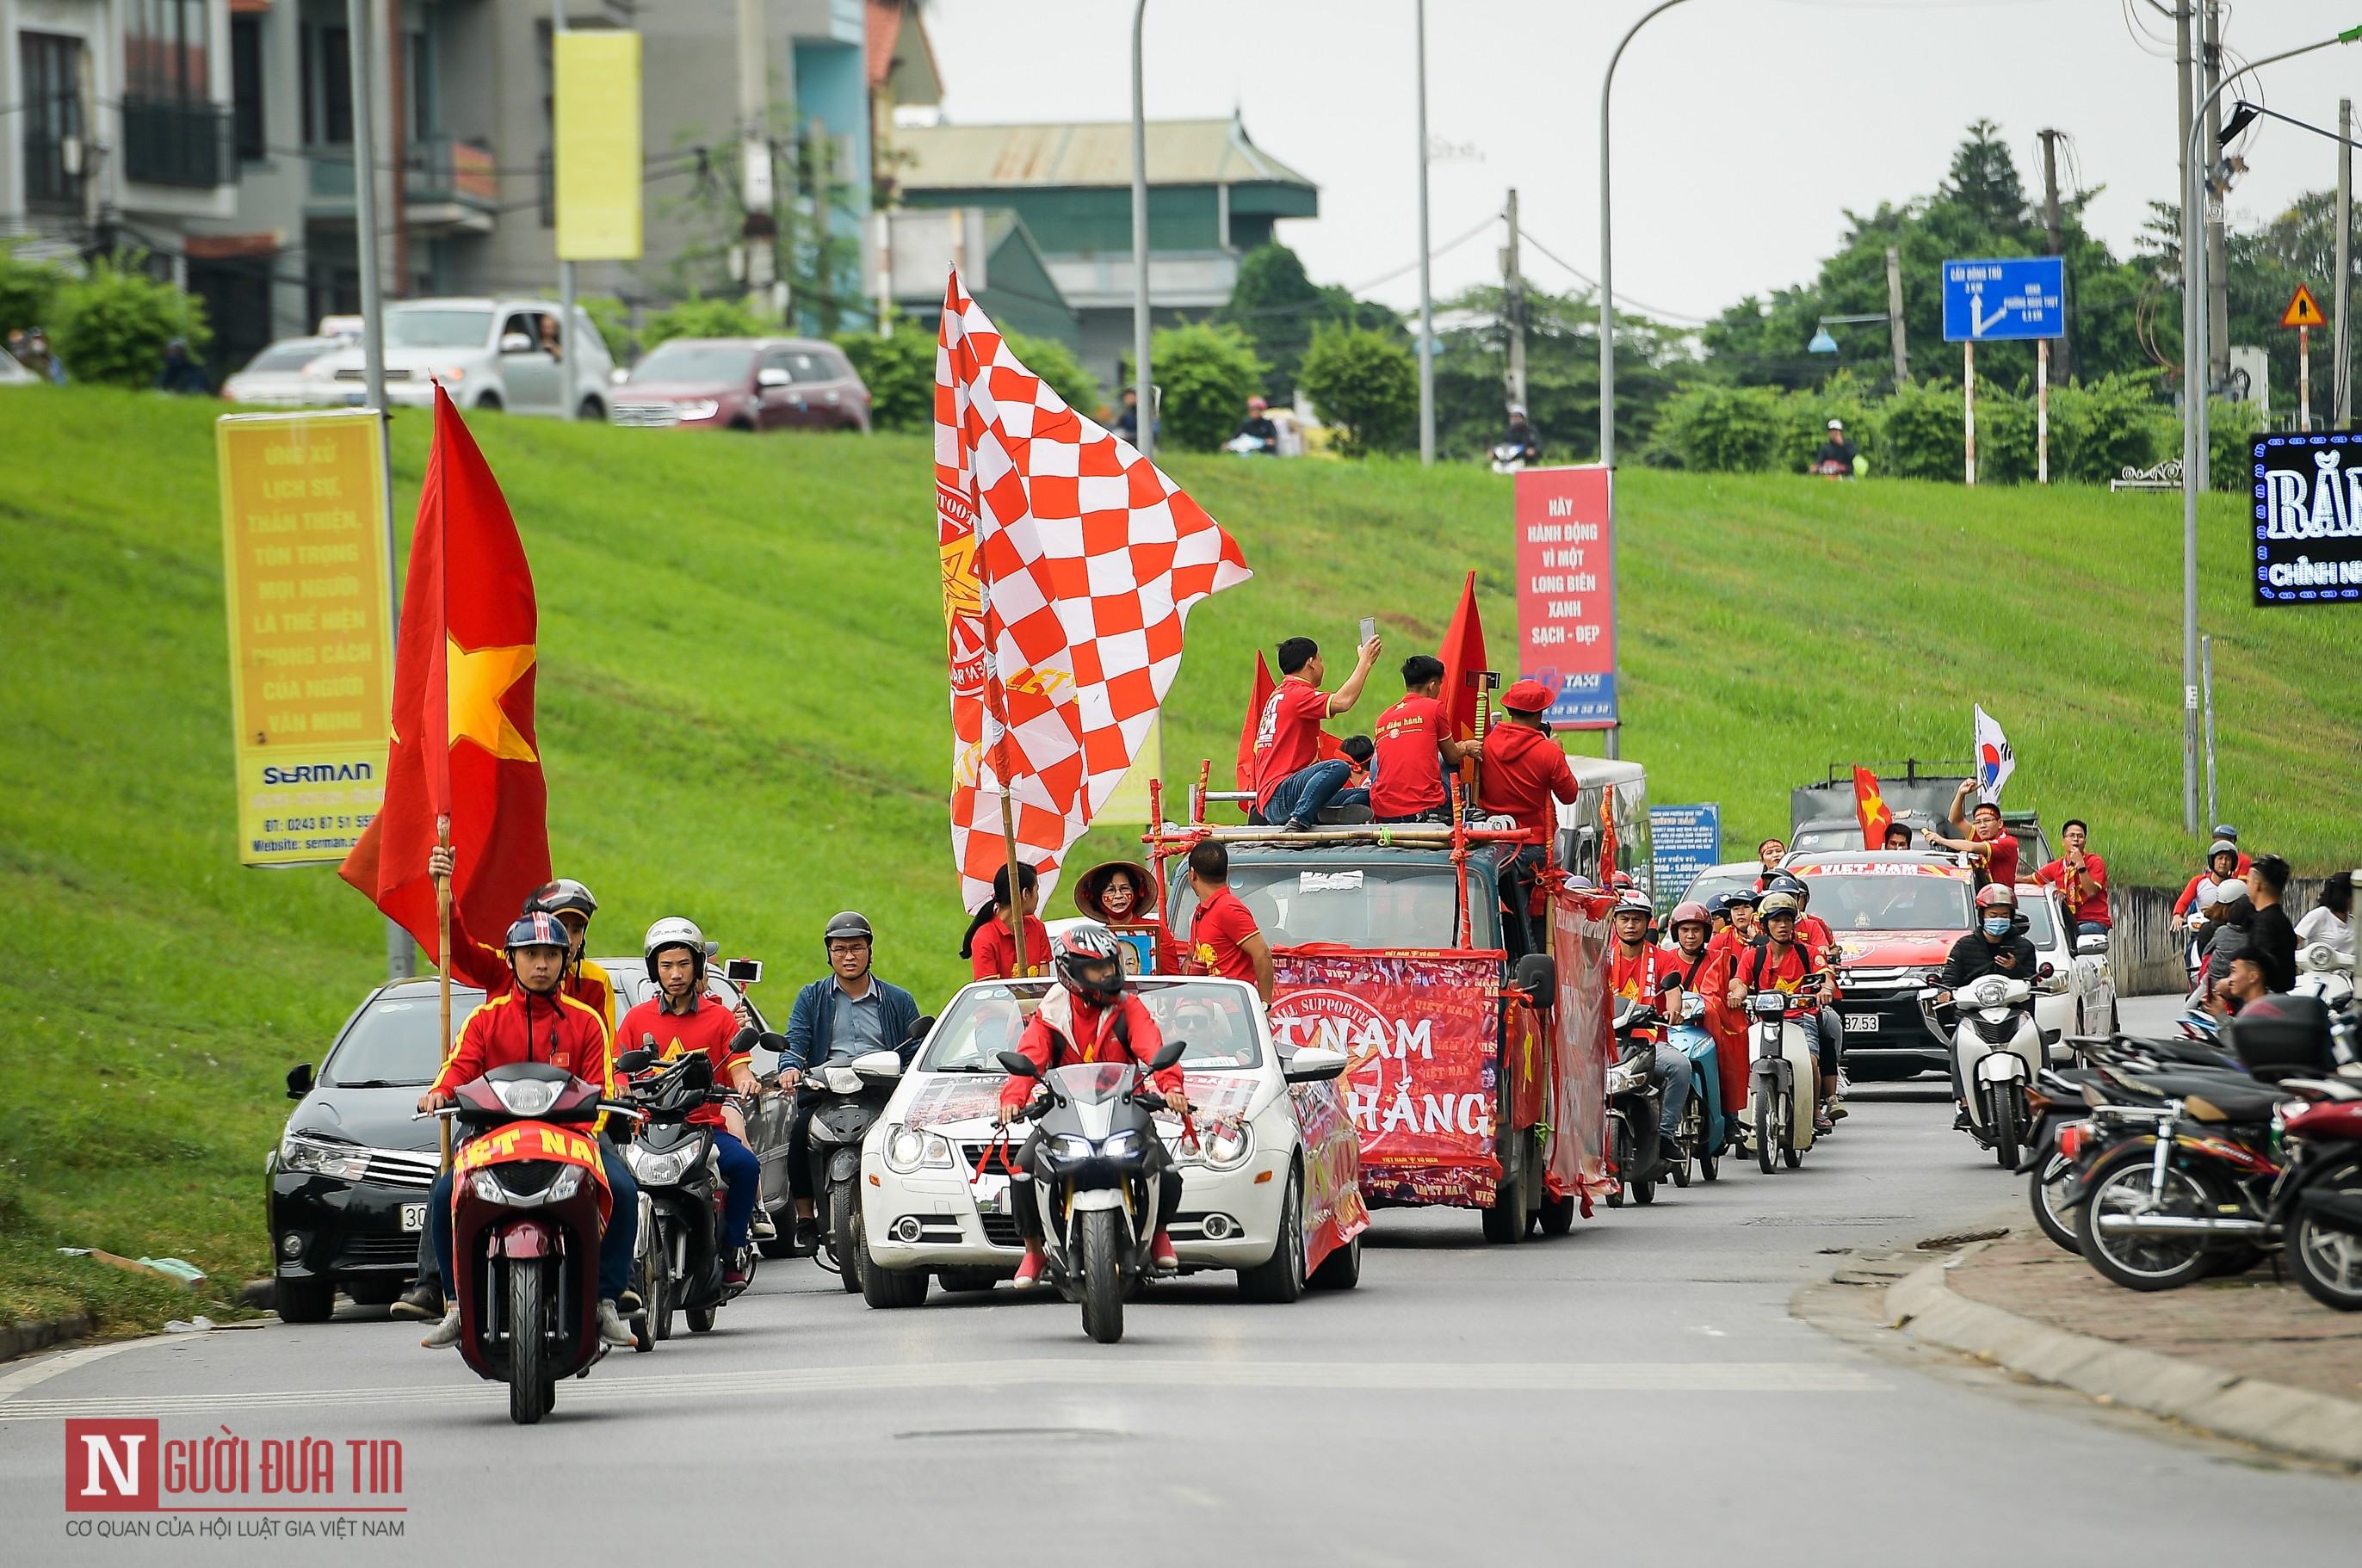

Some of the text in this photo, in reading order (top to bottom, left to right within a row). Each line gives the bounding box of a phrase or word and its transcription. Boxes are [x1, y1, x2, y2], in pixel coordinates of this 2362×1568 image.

[1528, 521, 1598, 544] HÀNH ĐỘNG
[1543, 547, 1584, 570] VÌ MỘT
[1531, 571, 1595, 593] LONG BIÊN
[1548, 601, 1581, 618] XANH
[1531, 627, 1565, 646] SẠCH
[1575, 626, 1600, 646] ĐẸP
[1565, 675, 1598, 688] TAXI
[263, 762, 372, 785] SERMAN
[254, 838, 300, 852] Website:
[1874, 863, 1918, 875] NAM
[1301, 997, 1371, 1028] SUPPORTE
[1319, 1017, 1432, 1060] NAM
[1346, 1076, 1489, 1139] HẮNG
[454, 1128, 521, 1176] IỆT
[405, 1207, 426, 1227] 30
